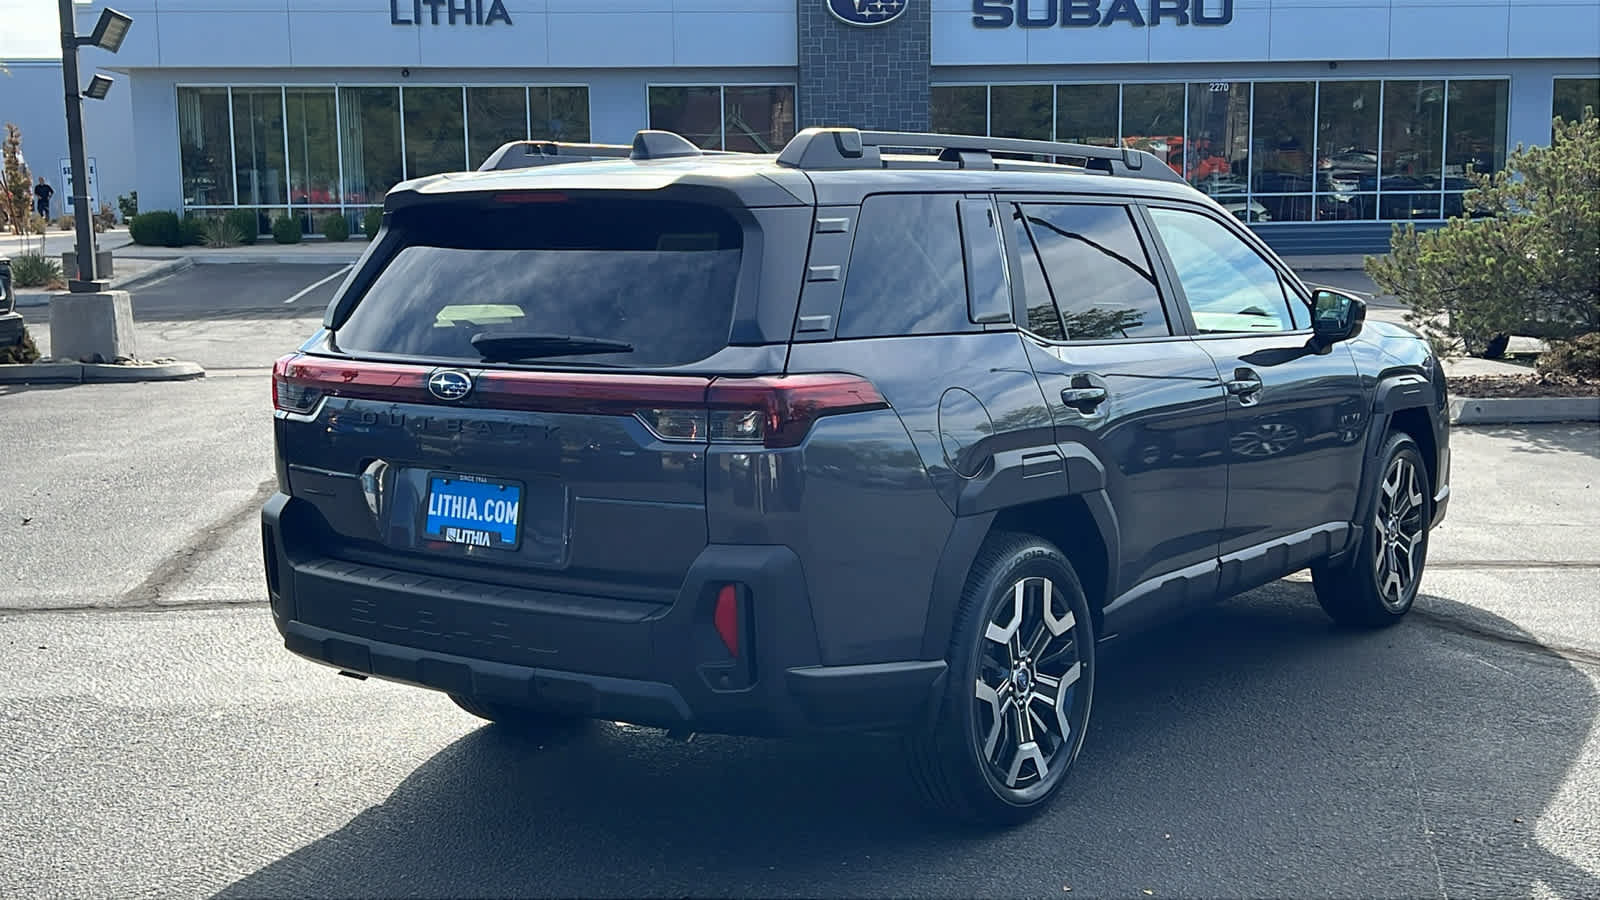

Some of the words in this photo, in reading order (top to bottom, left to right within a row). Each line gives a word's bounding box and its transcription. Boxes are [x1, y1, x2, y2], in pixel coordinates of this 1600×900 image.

[390, 0, 513, 26] LITHIA
[972, 0, 1234, 29] SUBARU
[1209, 83, 1229, 92] 2270
[428, 492, 519, 526] LITHIA.COM
[456, 529, 490, 547] LITHIA
